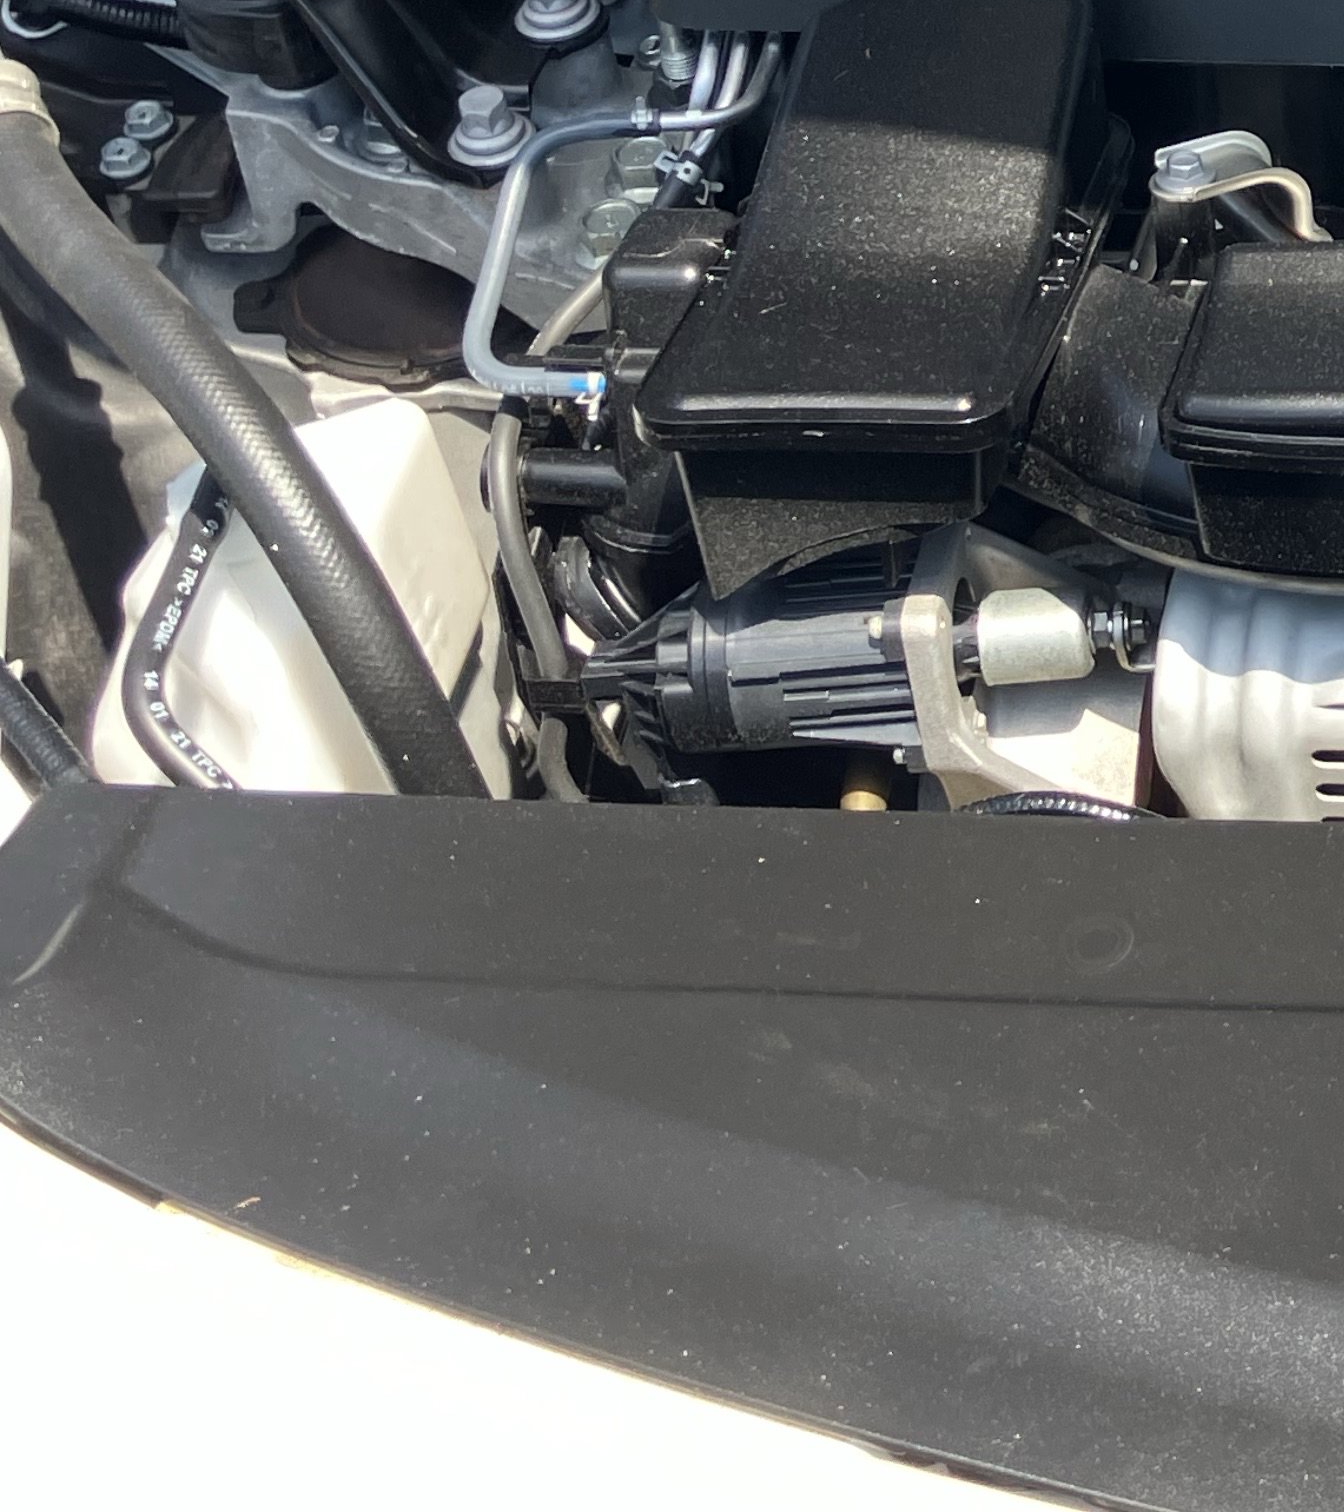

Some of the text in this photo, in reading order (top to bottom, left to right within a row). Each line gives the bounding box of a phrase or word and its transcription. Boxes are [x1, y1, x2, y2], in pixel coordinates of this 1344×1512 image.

[189, 543, 208, 565] 21
[176, 567, 199, 595] TPC
[150, 701, 170, 719] 01
[171, 730, 192, 750] 21
[192, 749, 221, 778] TPC
